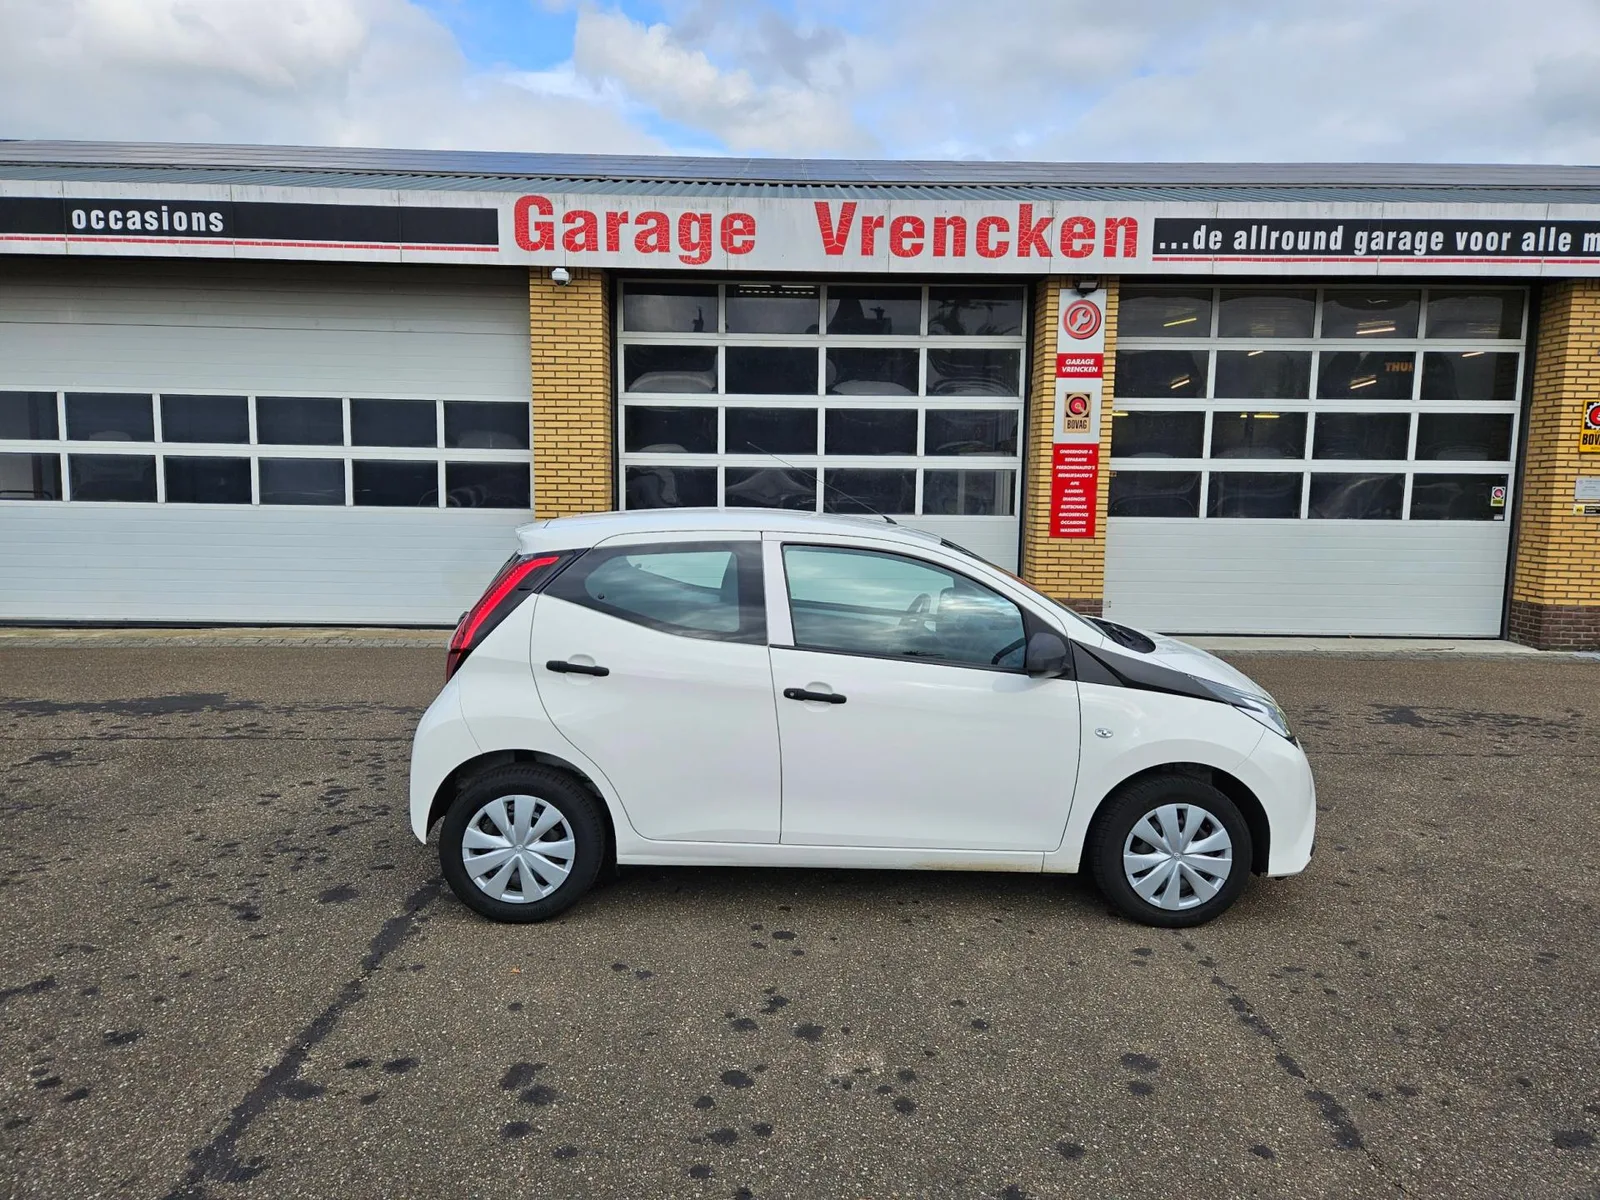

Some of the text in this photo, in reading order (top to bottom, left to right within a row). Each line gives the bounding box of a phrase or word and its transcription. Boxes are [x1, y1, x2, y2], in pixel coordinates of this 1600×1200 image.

[71, 205, 224, 233] occasions
[514, 195, 1138, 265] Garage Vrencken
[1233, 224, 1344, 252] allround
[1353, 230, 1444, 256] garage
[1455, 231, 1512, 252] voor
[1521, 226, 1572, 252] alle
[1066, 419, 1088, 430] BOVAG
